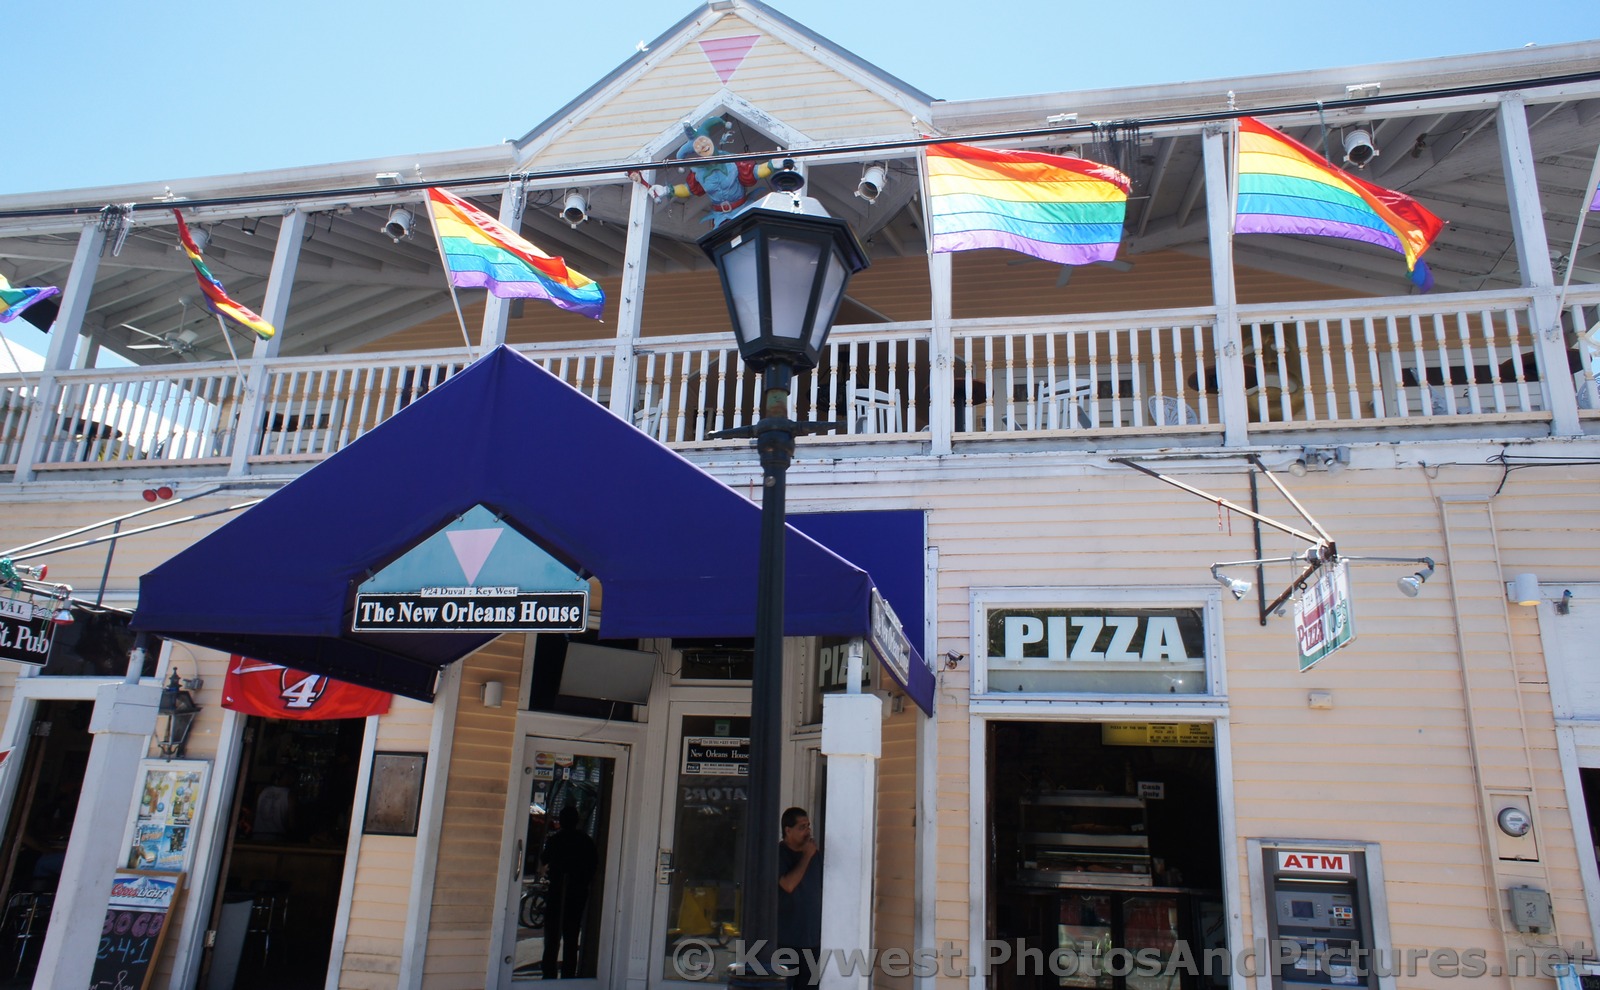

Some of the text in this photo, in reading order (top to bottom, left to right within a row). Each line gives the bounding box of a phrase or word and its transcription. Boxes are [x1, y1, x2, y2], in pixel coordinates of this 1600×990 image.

[423, 587, 438, 595] 724
[440, 587, 466, 595] Duval
[475, 587, 493, 597] Key
[495, 587, 516, 595] West
[360, 600, 580, 623] The New Orleans House
[13, 625, 50, 654] Pub
[1004, 616, 1188, 662] PIZZA
[819, 639, 871, 687] PIZA
[281, 674, 320, 708] 4
[690, 748, 749, 759] New Orleans House
[1283, 854, 1343, 870] ATM
[111, 882, 167, 898] Coors LIGHT
[102, 910, 166, 938] BOGO
